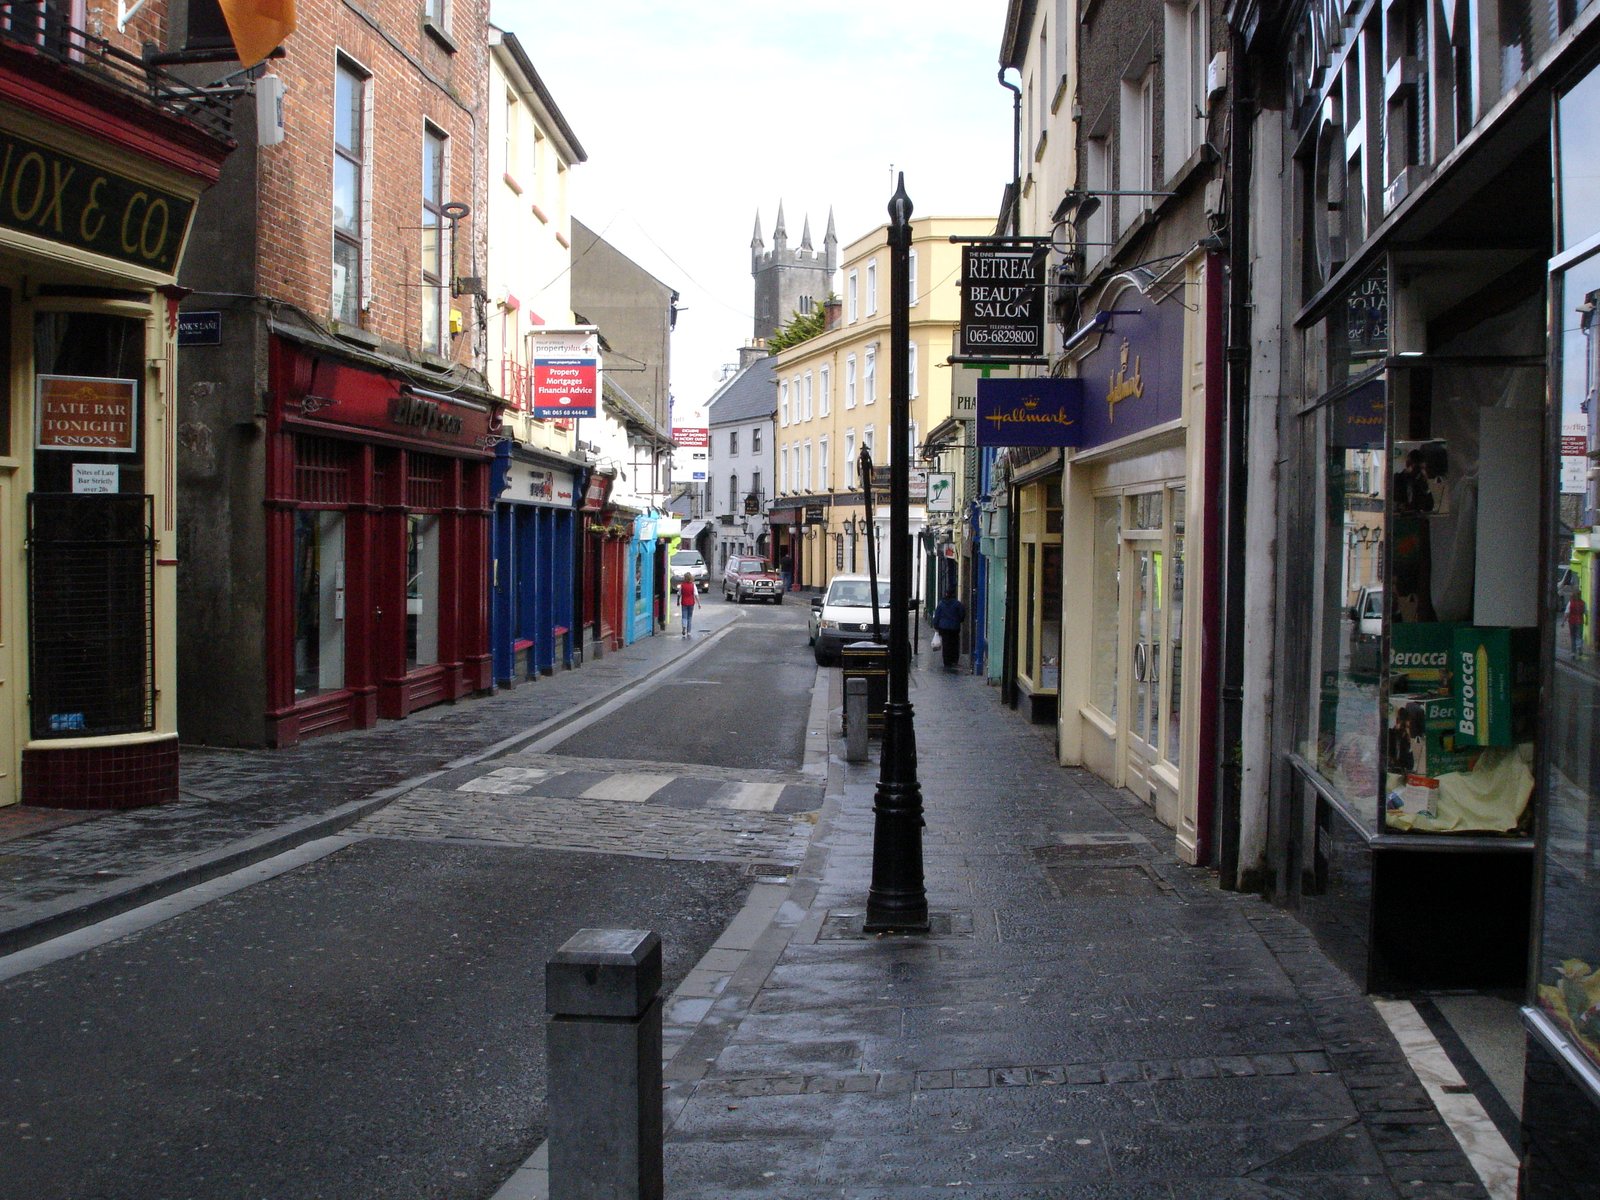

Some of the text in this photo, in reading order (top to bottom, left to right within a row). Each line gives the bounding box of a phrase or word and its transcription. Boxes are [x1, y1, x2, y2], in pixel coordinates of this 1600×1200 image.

[121, 191, 168, 264] CO.
[974, 302, 1031, 318] SALON
[969, 330, 1035, 343] 065-6829800
[536, 344, 581, 352] propertyplus
[549, 368, 580, 377] Property
[546, 378, 583, 386] Mortgages
[47, 402, 127, 416] LATE BAR
[985, 406, 1075, 431] Hallmark
[45, 419, 128, 433] TONIGHT
[54, 435, 118, 446] KNOX'S
[91, 478, 114, 486] Strictly
[1459, 651, 1475, 736] Berocca
